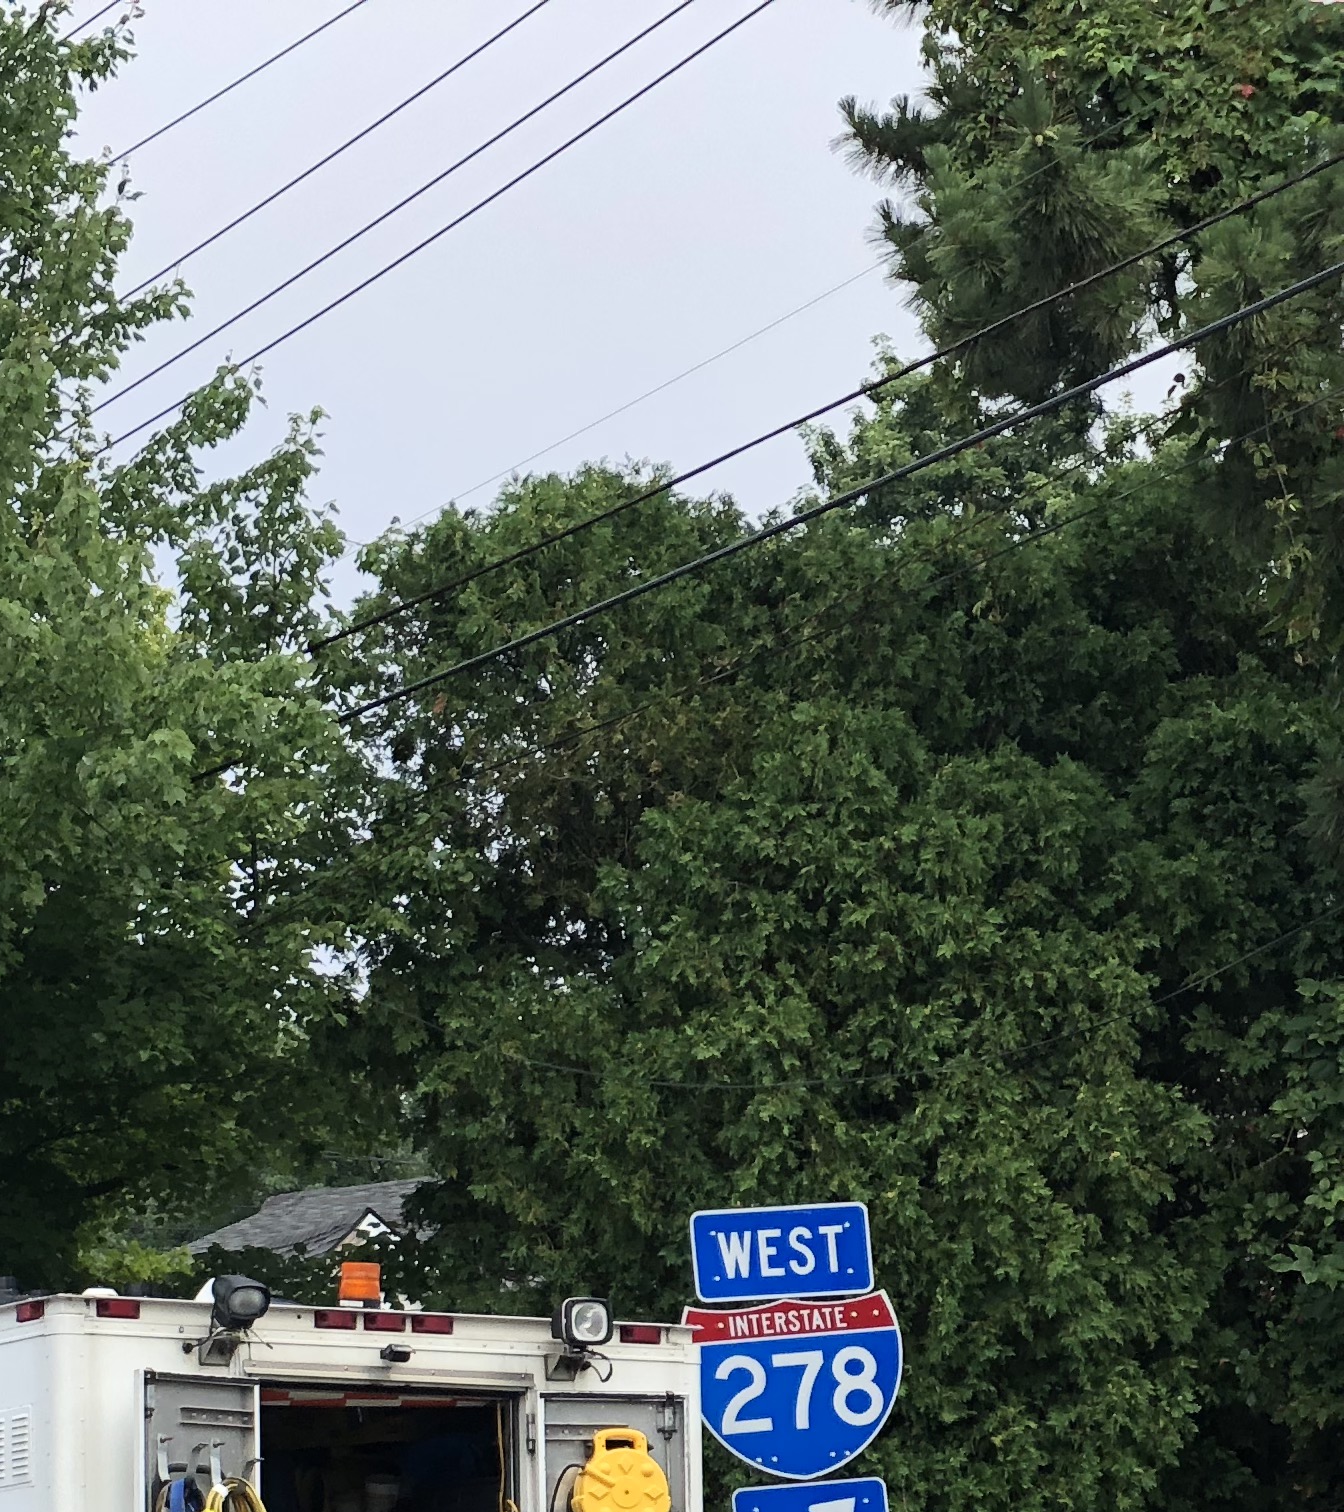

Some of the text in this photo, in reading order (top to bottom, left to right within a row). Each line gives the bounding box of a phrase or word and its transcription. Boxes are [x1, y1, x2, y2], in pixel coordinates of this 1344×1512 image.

[717, 1225, 844, 1279] WEST
[728, 1307, 848, 1337] INTERSTATE
[715, 1346, 884, 1435] 278
